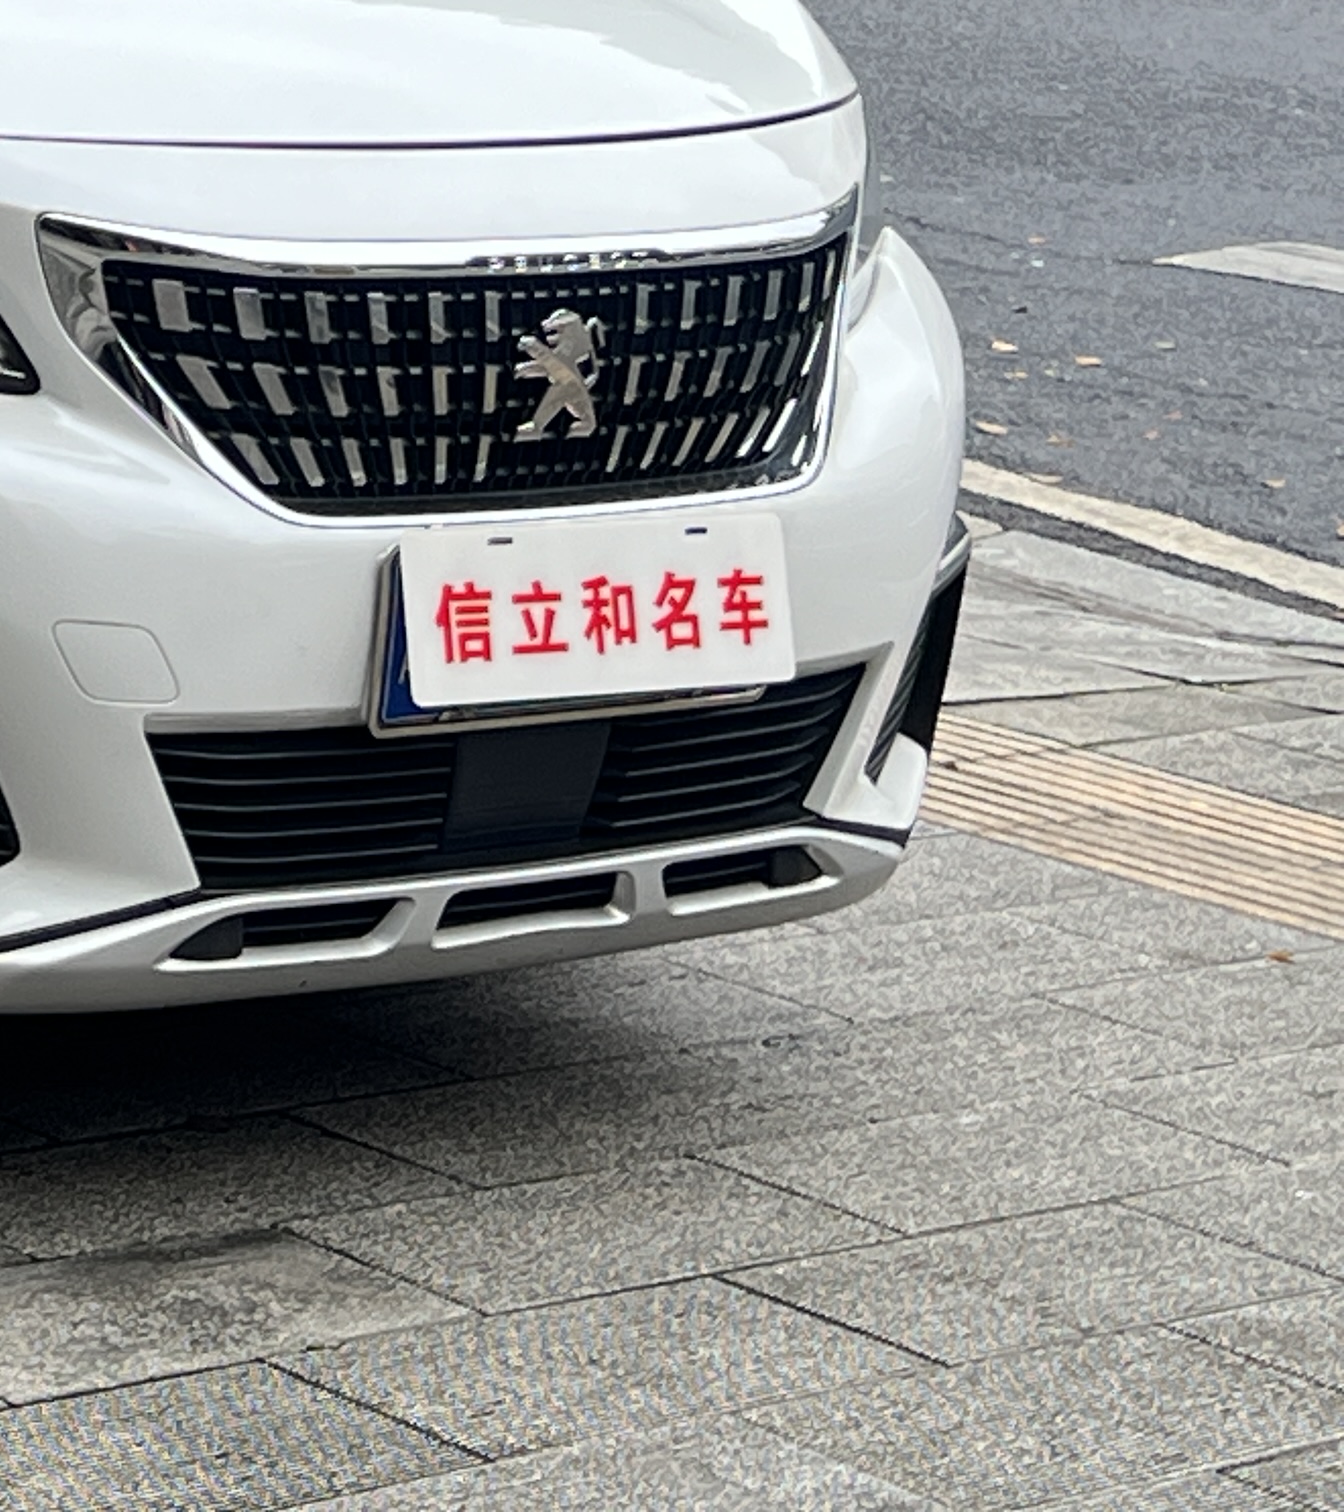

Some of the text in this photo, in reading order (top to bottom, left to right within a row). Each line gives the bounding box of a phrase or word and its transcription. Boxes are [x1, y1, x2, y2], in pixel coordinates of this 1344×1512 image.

[434, 568, 769, 664] 信立和名车
